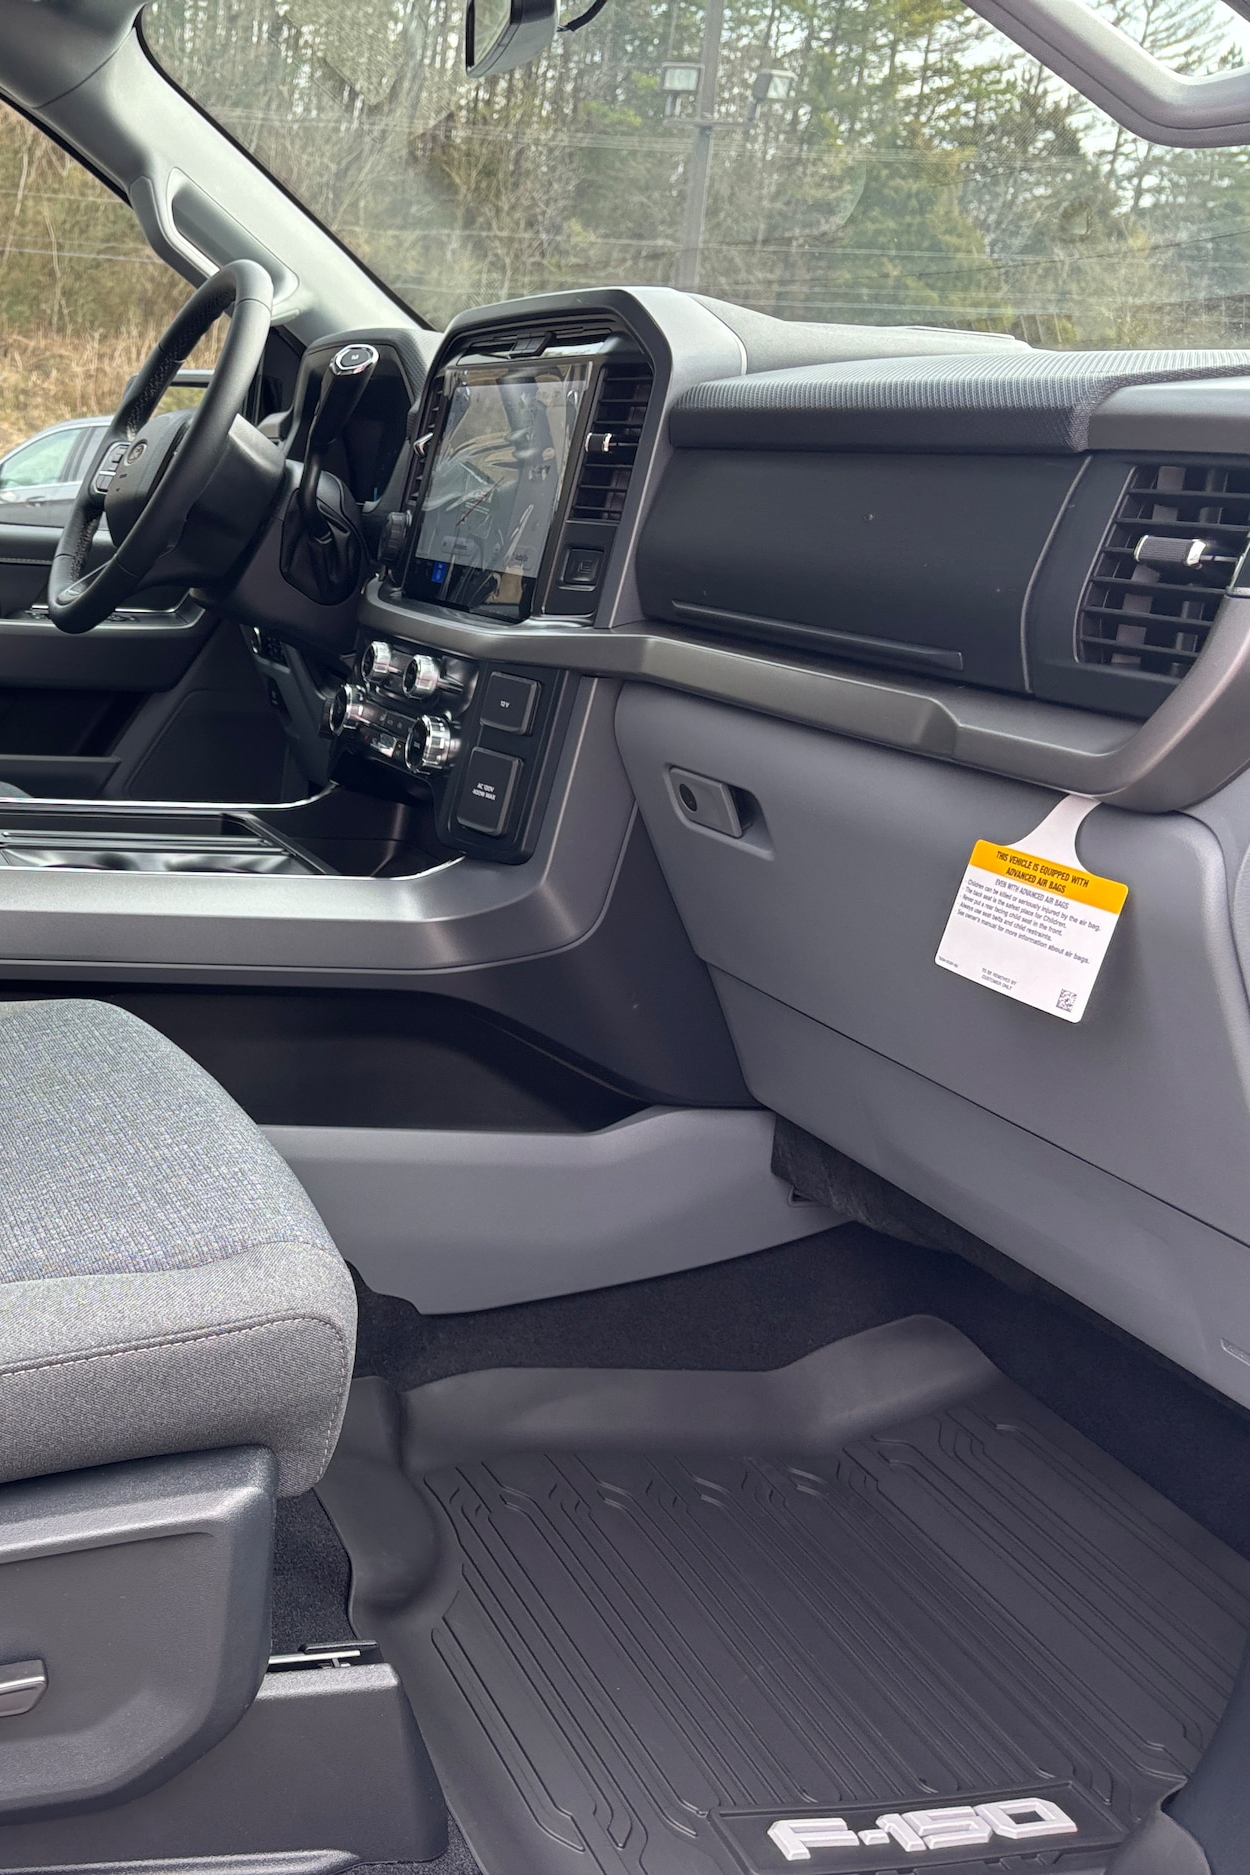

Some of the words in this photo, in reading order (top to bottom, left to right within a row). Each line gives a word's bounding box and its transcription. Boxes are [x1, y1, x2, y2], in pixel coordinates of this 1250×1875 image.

[996, 851, 1008, 862] THIS
[1009, 855, 1032, 869] VEHICLE
[1033, 862, 1039, 871] IS
[1040, 864, 1070, 882] EQUIPPED
[1071, 875, 1089, 888] WITH
[1006, 867, 1036, 883] ADVANCED
[1036, 877, 1049, 887] AIR
[1049, 880, 1066, 894] BAGS
[968, 879, 984, 889] Children
[999, 891, 1012, 899] killed
[1018, 898, 1041, 911] seriously
[1042, 905, 1060, 917] injured
[1088, 921, 1101, 932] bag.
[973, 889, 983, 897] back
[1006, 902, 1020, 911] safest
[1020, 908, 1034, 916] place
[1043, 915, 1066, 928] Children.
[995, 879, 1007, 888] EVEN
[1007, 883, 1019, 892] WITH
[1019, 887, 1044, 901] ADVANCED
[1045, 896, 1054, 904] AIR
[1054, 899, 1069, 910] BAGS
[960, 902, 973, 912] Always
[992, 915, 1003, 923] belts
[1013, 922, 1026, 931] child
[1026, 928, 1052, 941] restraints.
[963, 894, 974, 902] Never
[994, 906, 1008, 917] facing
[1009, 912, 1021, 920] child
[1022, 917, 1032, 925] seat
[1048, 926, 1062, 936] front.
[965, 913, 980, 922] owner's
[981, 919, 997, 929] manual
[1005, 928, 1017, 937] more
[1019, 932, 1047, 949] information
[1048, 945, 1065, 954] about
[1073, 953, 1089, 964] bags.
[767, 1797, 1078, 1861] F-150
